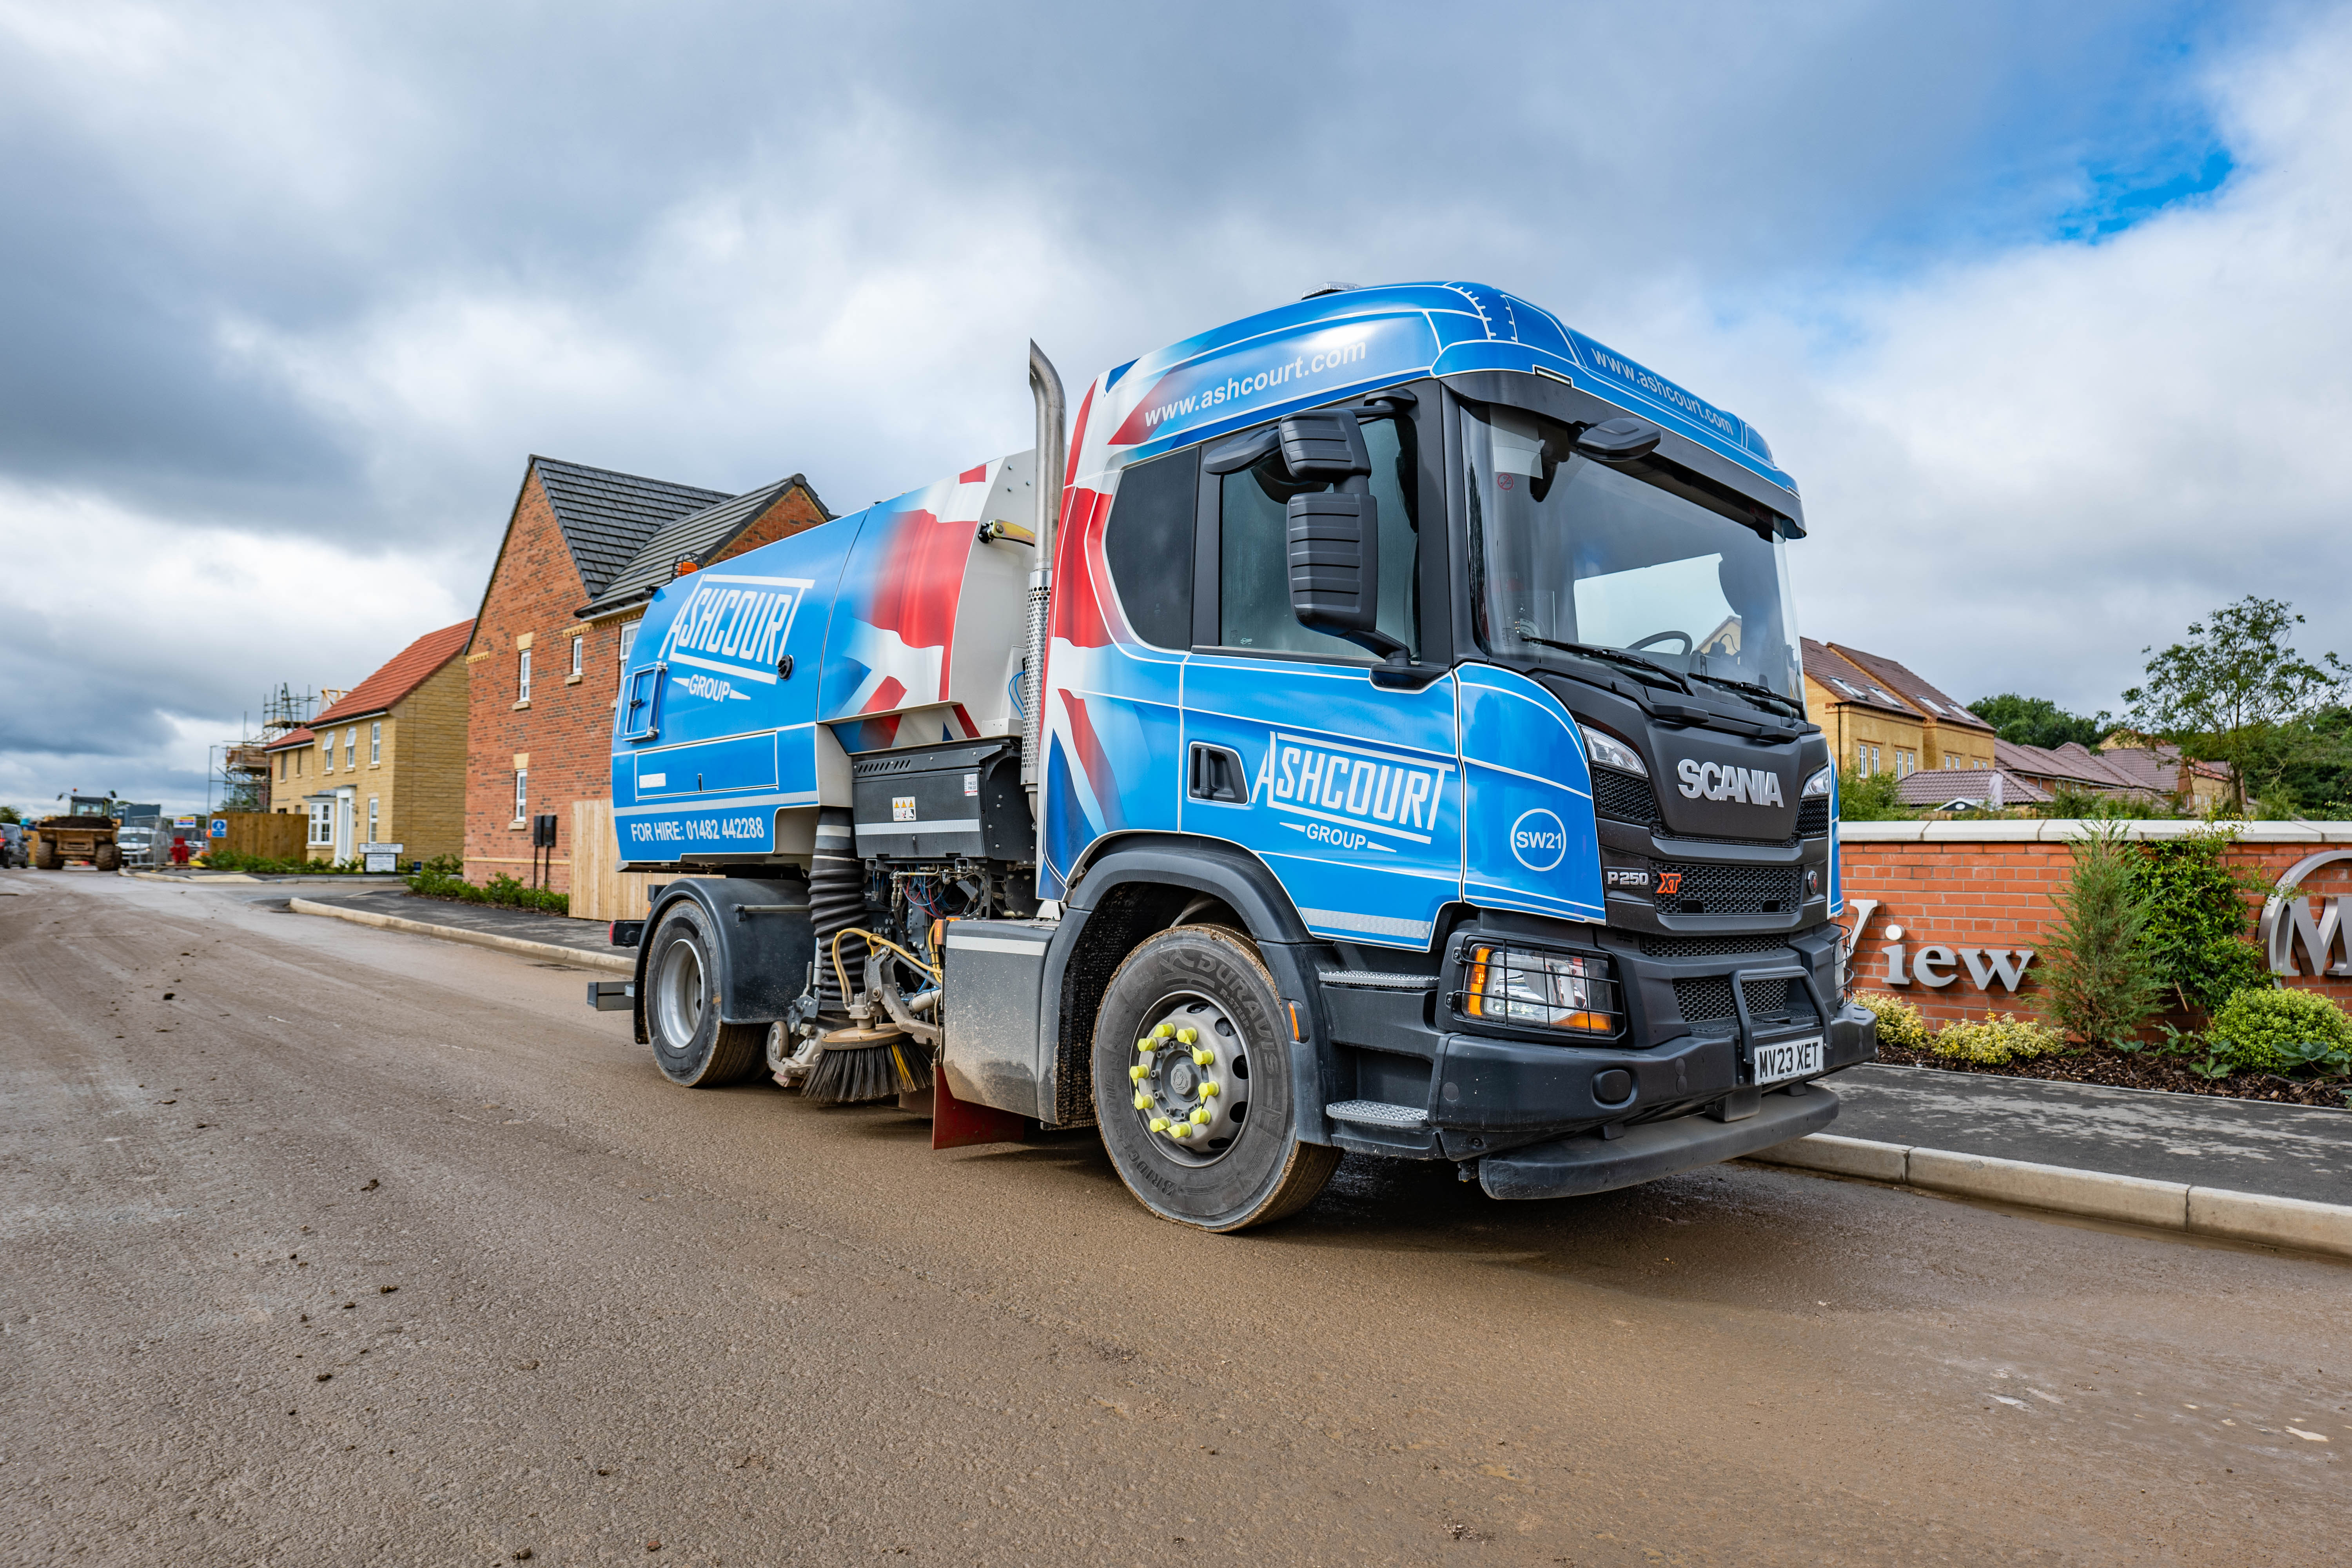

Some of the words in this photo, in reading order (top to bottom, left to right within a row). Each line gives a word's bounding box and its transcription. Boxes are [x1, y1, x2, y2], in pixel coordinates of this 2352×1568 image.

[1145, 341, 1367, 427] www.ashcourt.com
[1591, 348, 1734, 436] www.ashcourt.com
[657, 573, 815, 666] ASHCOURT
[689, 674, 731, 702] GROUP
[1250, 731, 1455, 831] ASHCOURT
[1677, 759, 1784, 808] SCANIA
[630, 823, 654, 842] FOR
[654, 821, 685, 841] HIRE:
[686, 819, 720, 840] 01482
[722, 817, 764, 838] 442288
[1307, 823, 1366, 850] GROUP
[1516, 831, 1561, 849] SW21
[1657, 873, 1681, 893] XT
[1197, 954, 1279, 1074] DURAVIS
[1220, 987, 1249, 1028] R-STEER
[1759, 1046, 1793, 1078] MV23
[1797, 1042, 1818, 1071] XET
[1104, 1073, 1177, 1197] BRIDGESTONE
